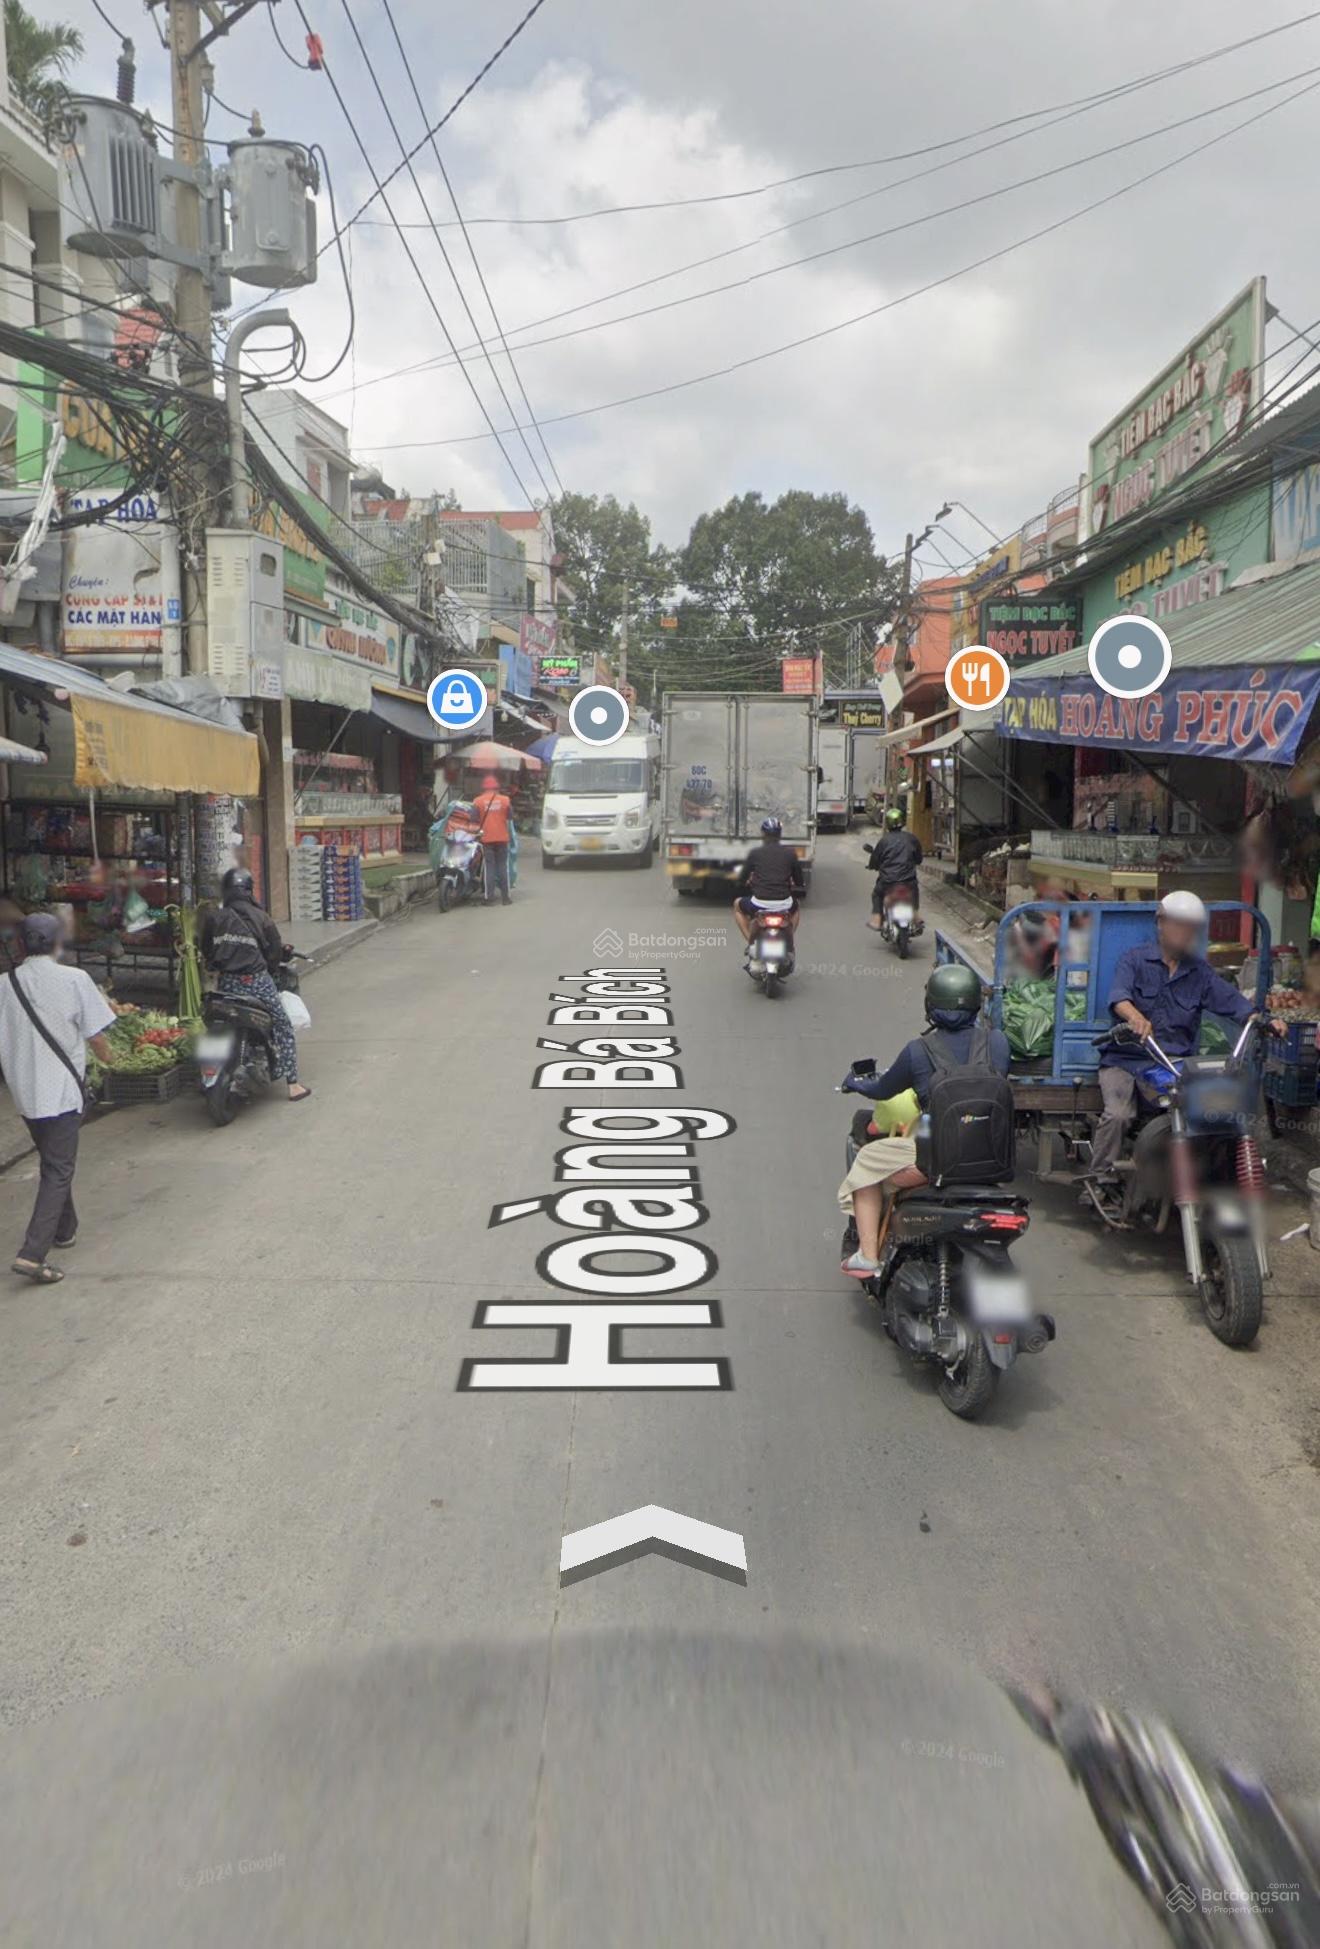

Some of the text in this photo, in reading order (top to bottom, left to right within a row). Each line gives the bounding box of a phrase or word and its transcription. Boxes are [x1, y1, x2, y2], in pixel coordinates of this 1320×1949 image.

[1148, 389, 1174, 437] BẠC
[67, 606, 93, 624] CÁC
[987, 622, 1076, 660] NGỌC TUYẾT
[1029, 691, 1057, 731] HÓA
